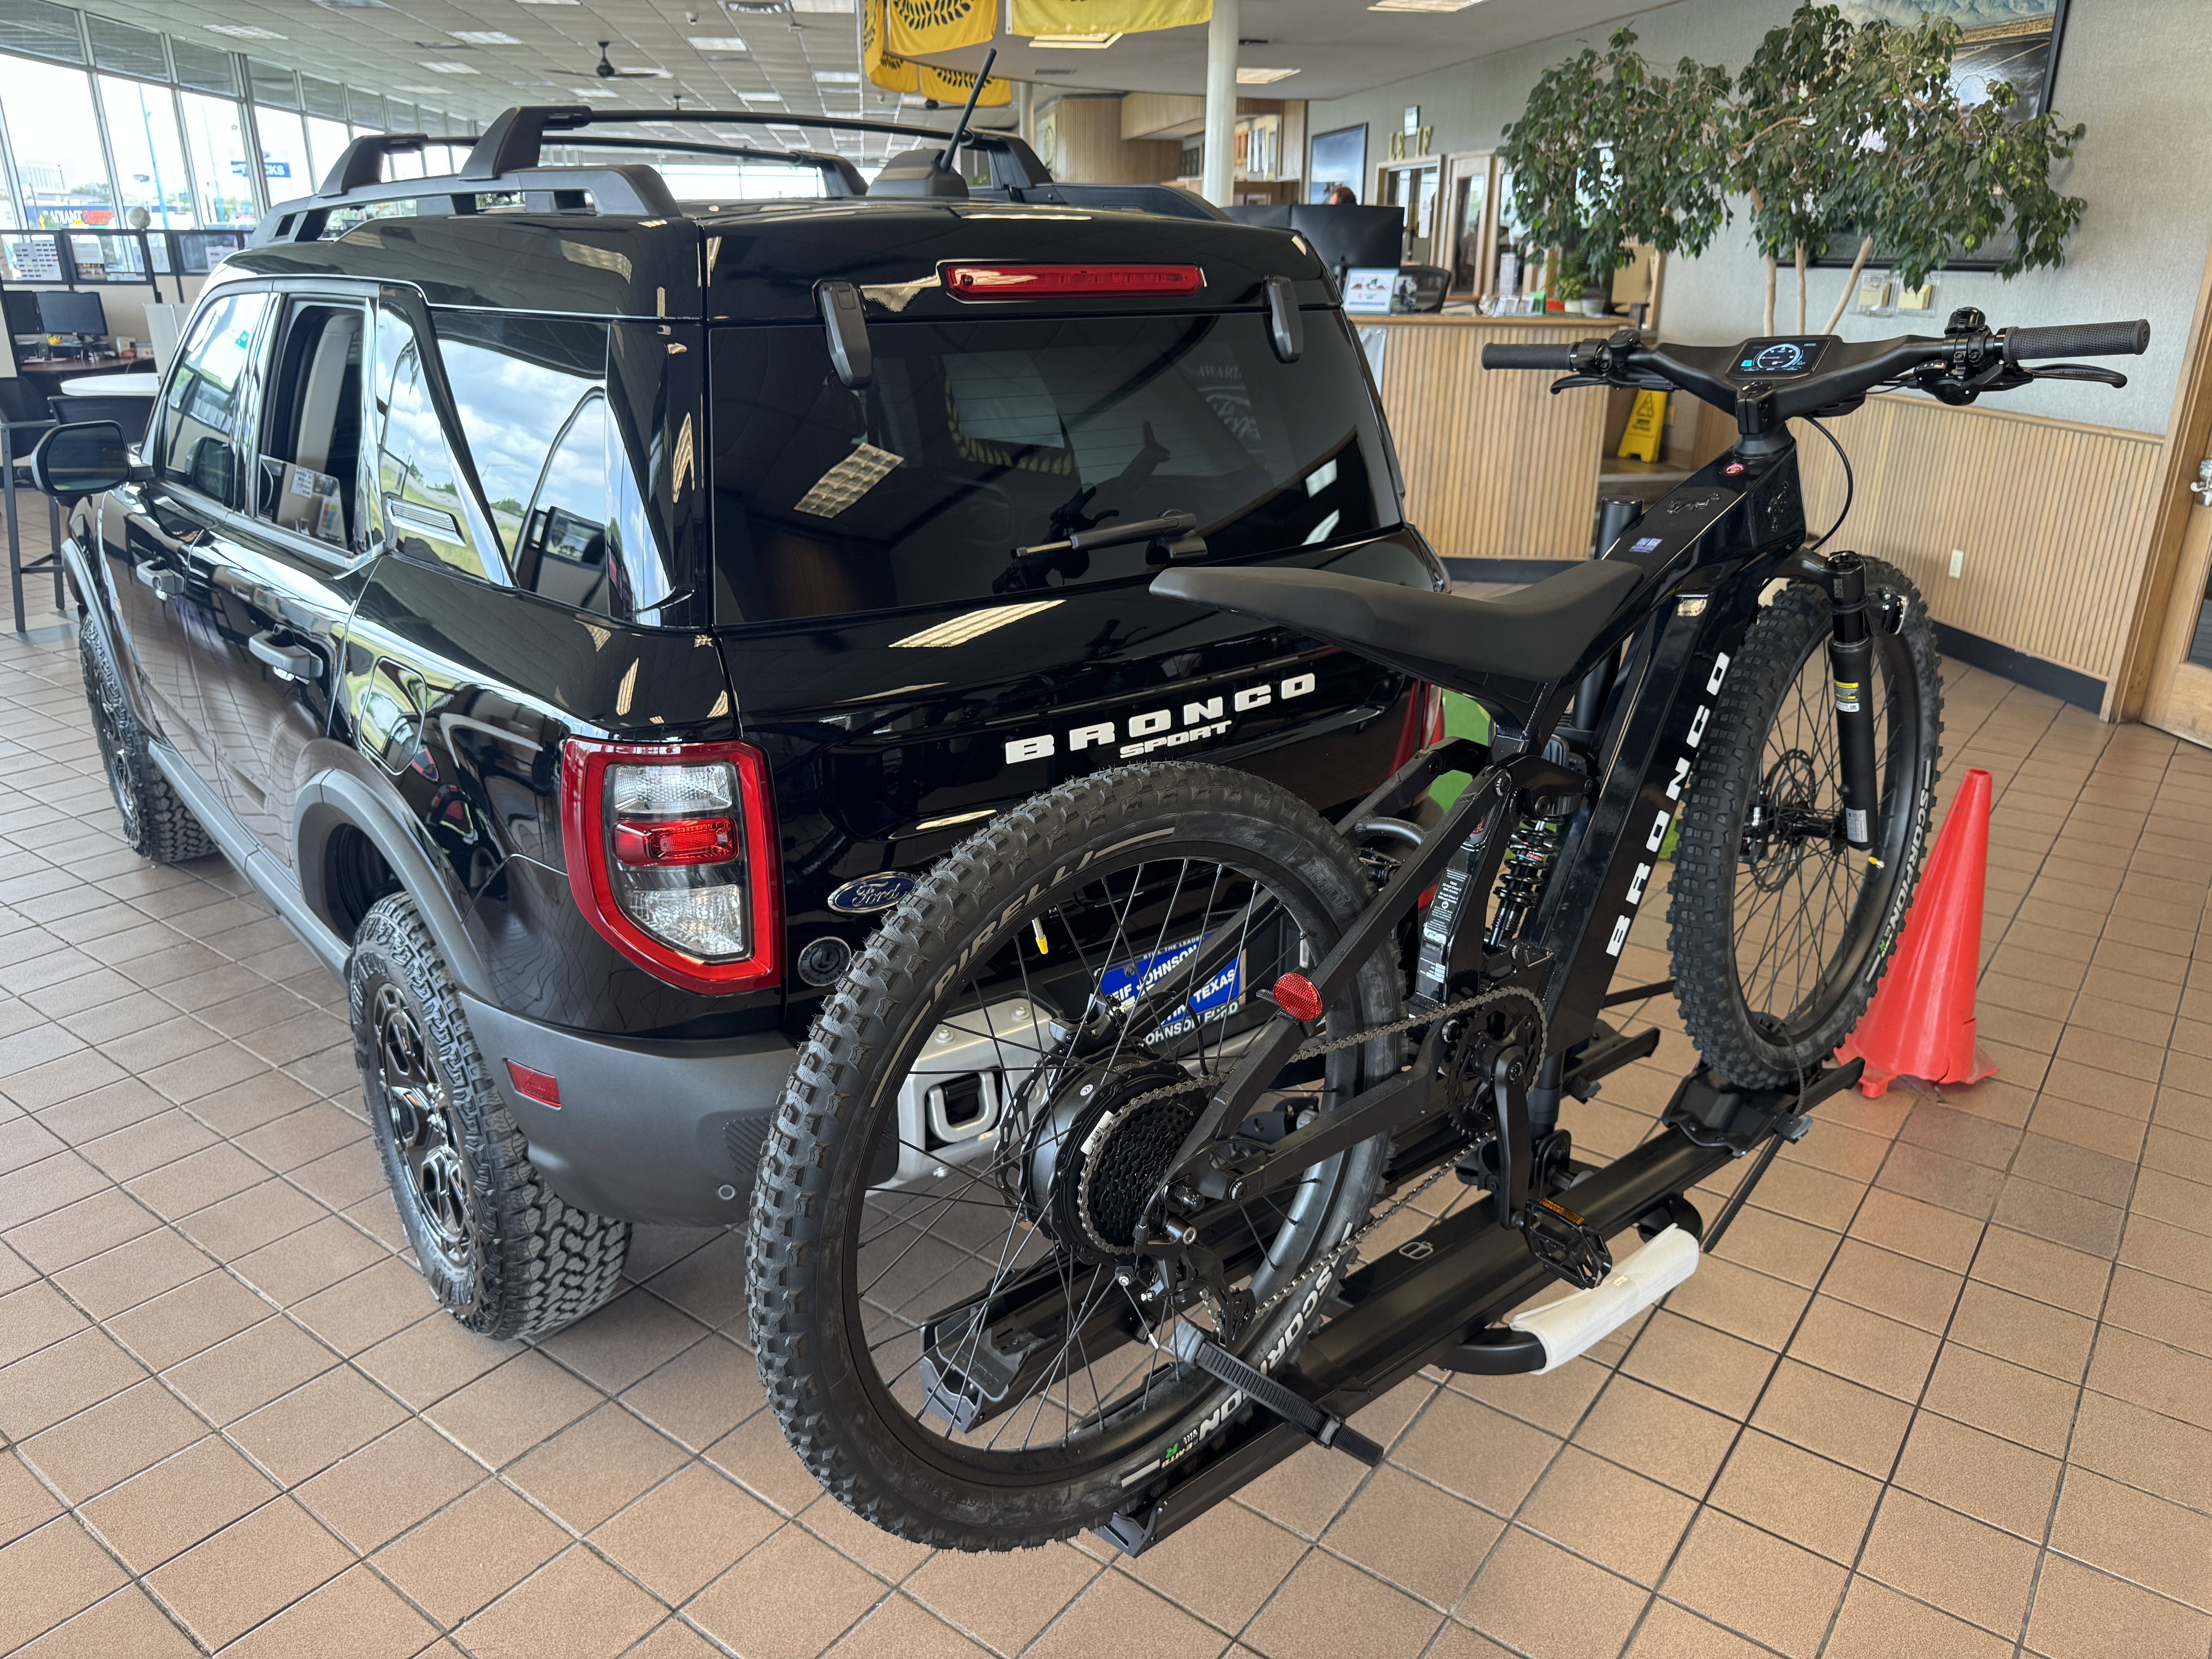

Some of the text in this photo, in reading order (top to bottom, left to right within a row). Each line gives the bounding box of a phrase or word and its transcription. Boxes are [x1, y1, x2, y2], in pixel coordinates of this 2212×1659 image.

[1005, 673, 1315, 764] BRONCO
[1120, 720, 1232, 759] SPORT
[1606, 652, 1730, 957] BRONCO
[1890, 789, 1930, 929] SCORPION
[852, 881, 901, 907] Ford
[934, 850, 1093, 1003] PIRELLI
[1143, 950, 1161, 960] STIL
[1194, 969, 1236, 1003] TEXAS
[1111, 983, 1132, 1001] EIF
[1199, 1265, 1333, 1441] SCORON
